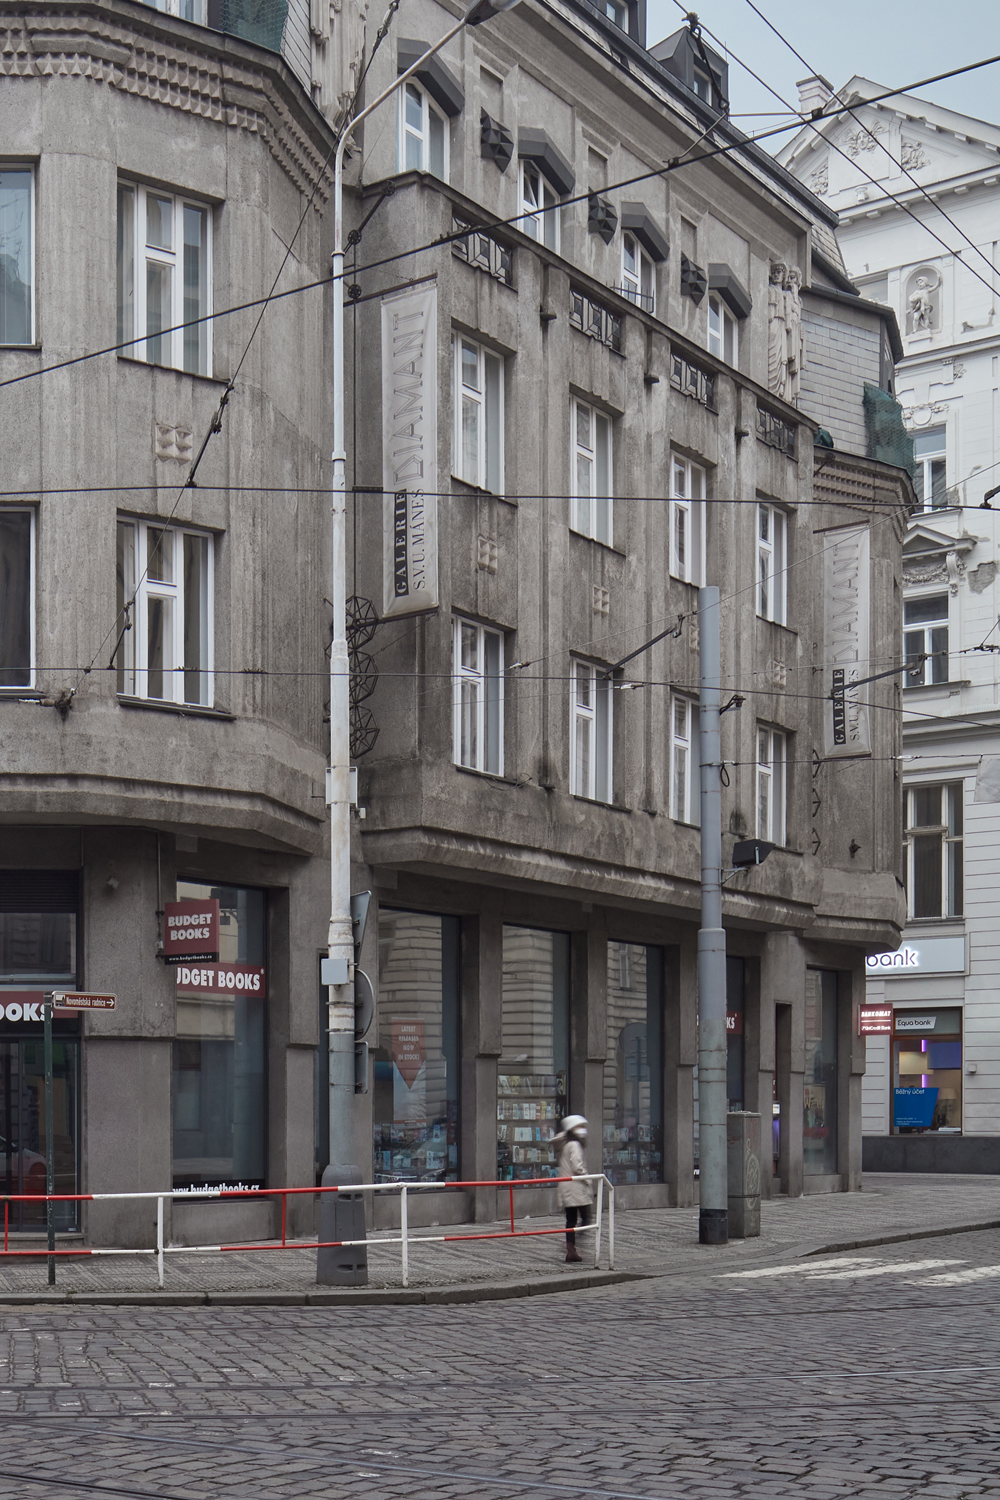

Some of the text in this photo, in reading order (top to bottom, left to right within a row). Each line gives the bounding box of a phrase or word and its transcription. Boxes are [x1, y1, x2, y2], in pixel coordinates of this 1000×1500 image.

[393, 311, 424, 485] DIAMANT
[395, 492, 408, 594] GALERIE
[832, 544, 859, 663] DIAMANT
[168, 913, 213, 927] BUDGET
[170, 927, 210, 941] BOOKS
[218, 971, 260, 991] BOOKS
[861, 1010, 892, 1018] BANKOMAT
[897, 1019, 914, 1027] Equa
